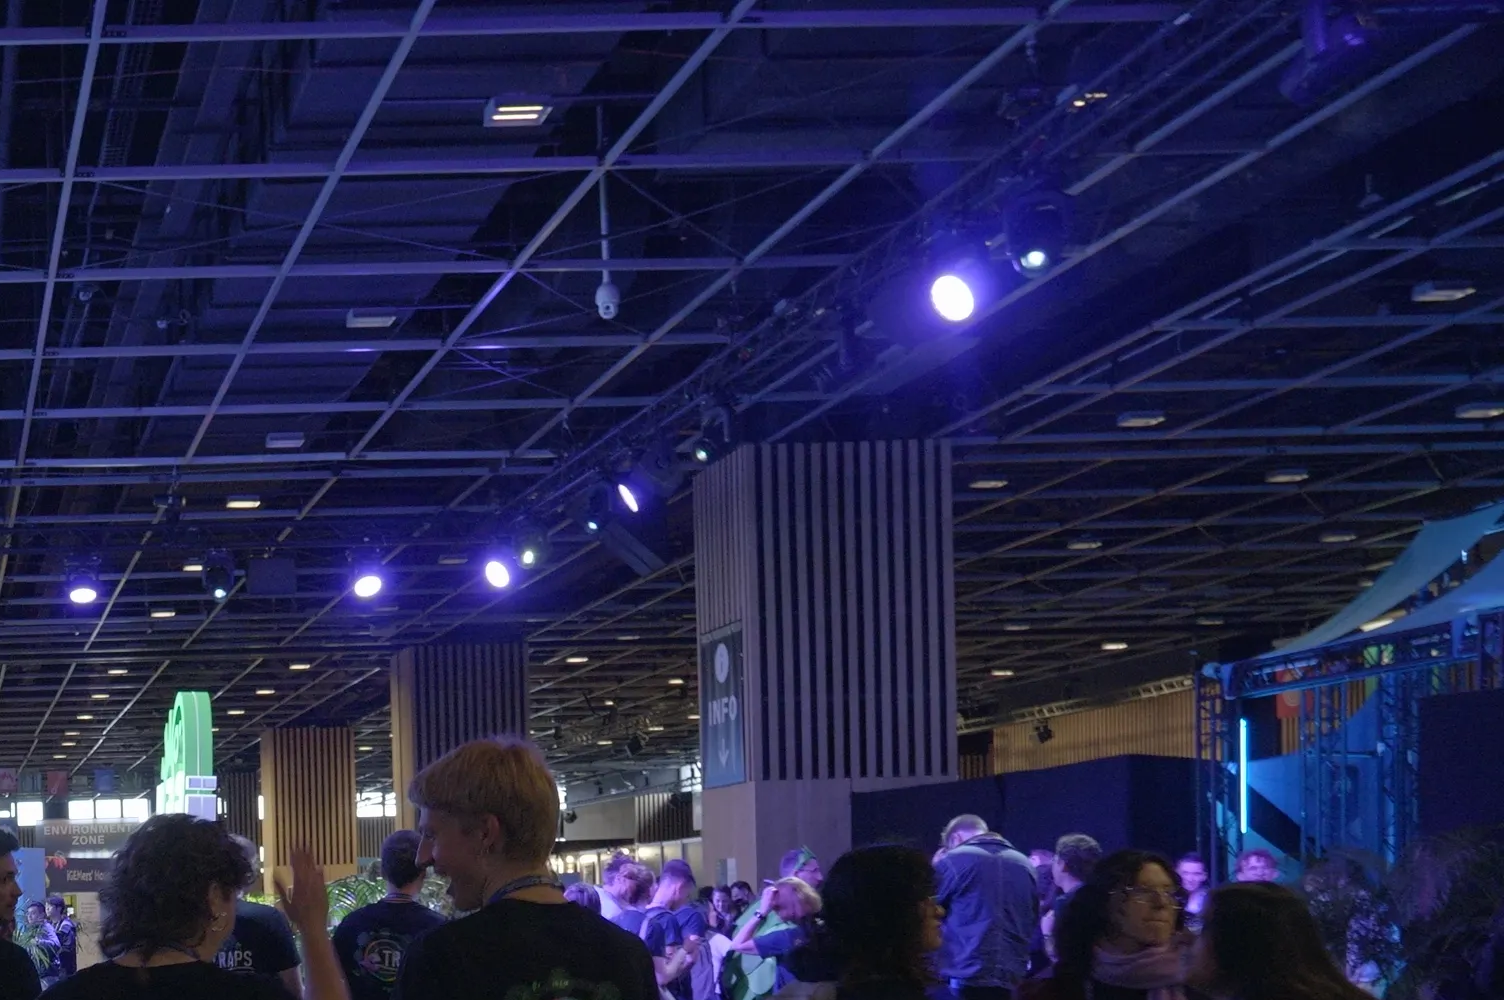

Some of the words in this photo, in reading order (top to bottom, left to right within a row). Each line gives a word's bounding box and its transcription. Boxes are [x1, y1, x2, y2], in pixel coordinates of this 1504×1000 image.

[708, 694, 738, 727] INFO
[43, 823, 133, 836] ENVIRONMENT
[71, 834, 105, 846] ZONE
